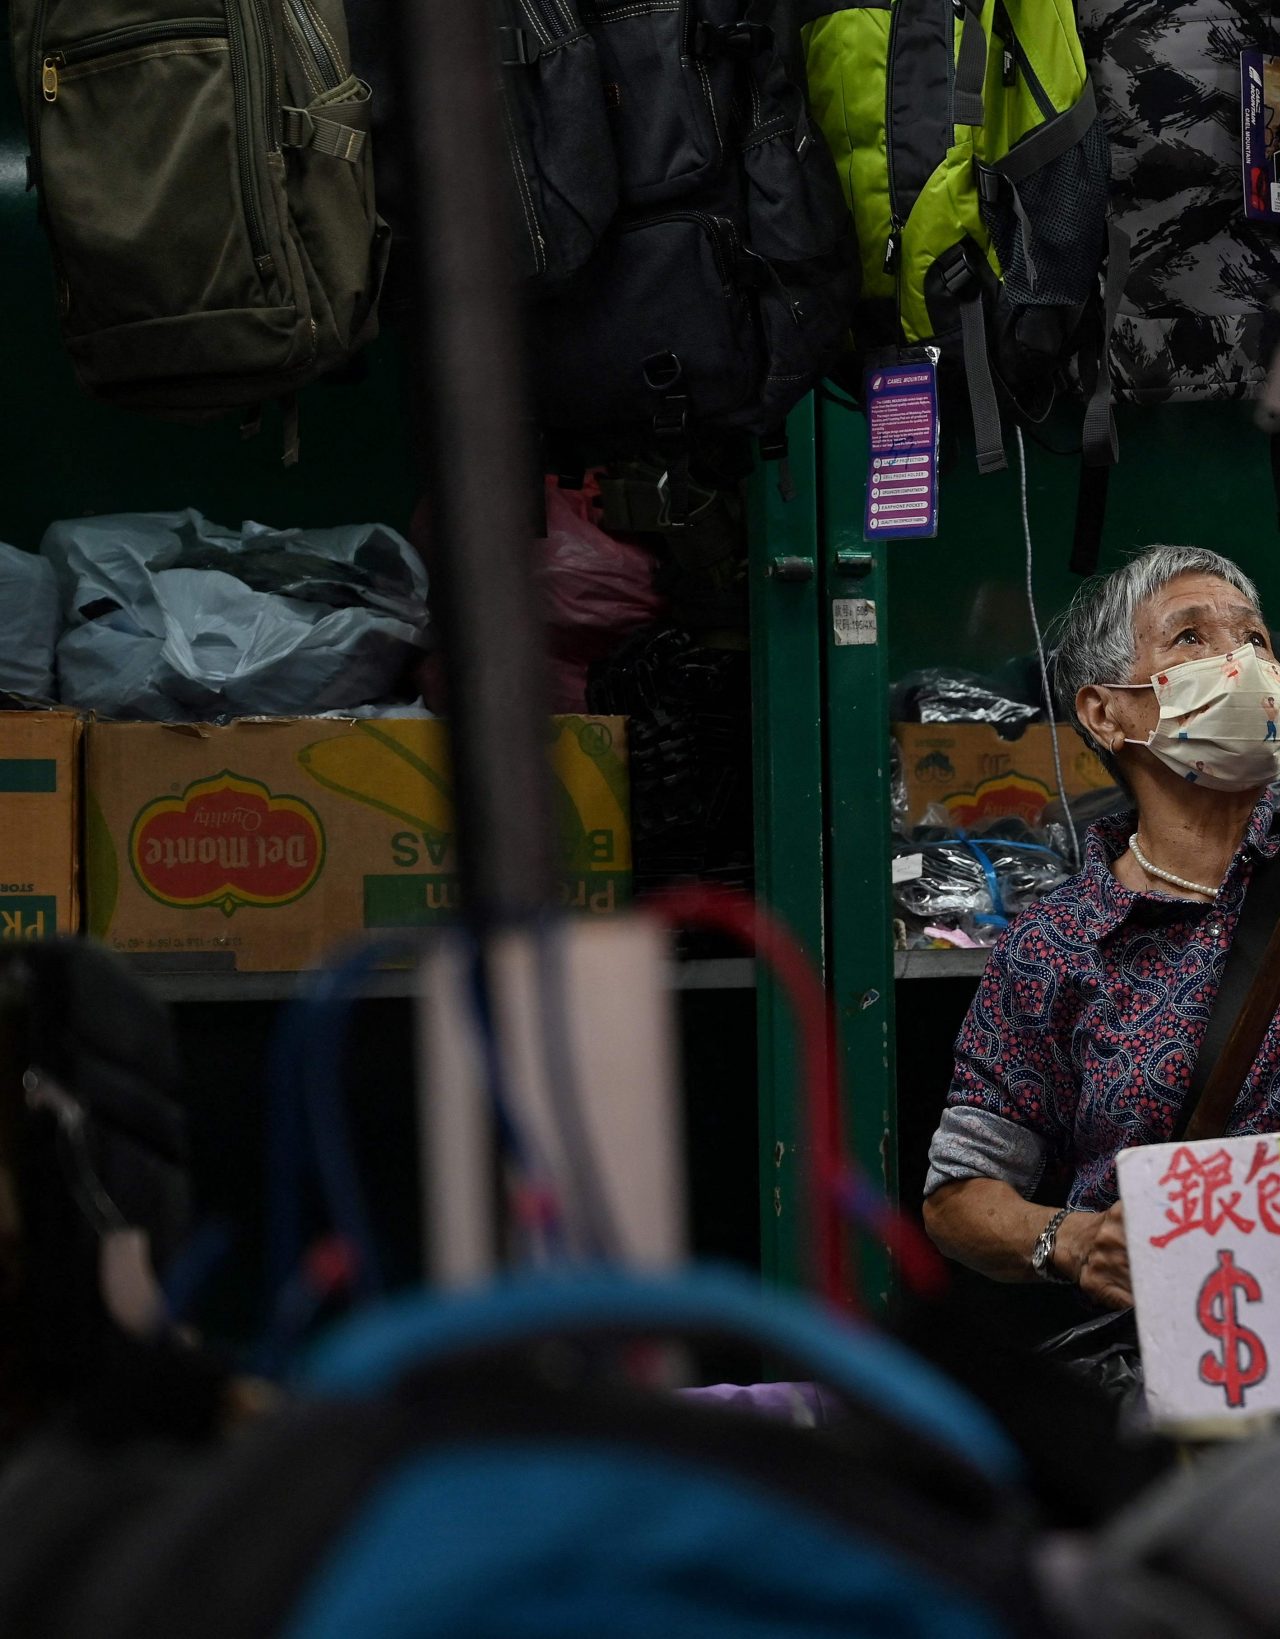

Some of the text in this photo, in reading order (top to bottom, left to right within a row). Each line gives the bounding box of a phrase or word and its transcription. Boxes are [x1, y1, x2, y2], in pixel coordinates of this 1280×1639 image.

[903, 375, 929, 383] MOUNTAIN
[193, 806, 262, 832] Quality
[145, 834, 308, 870] Del Monte
